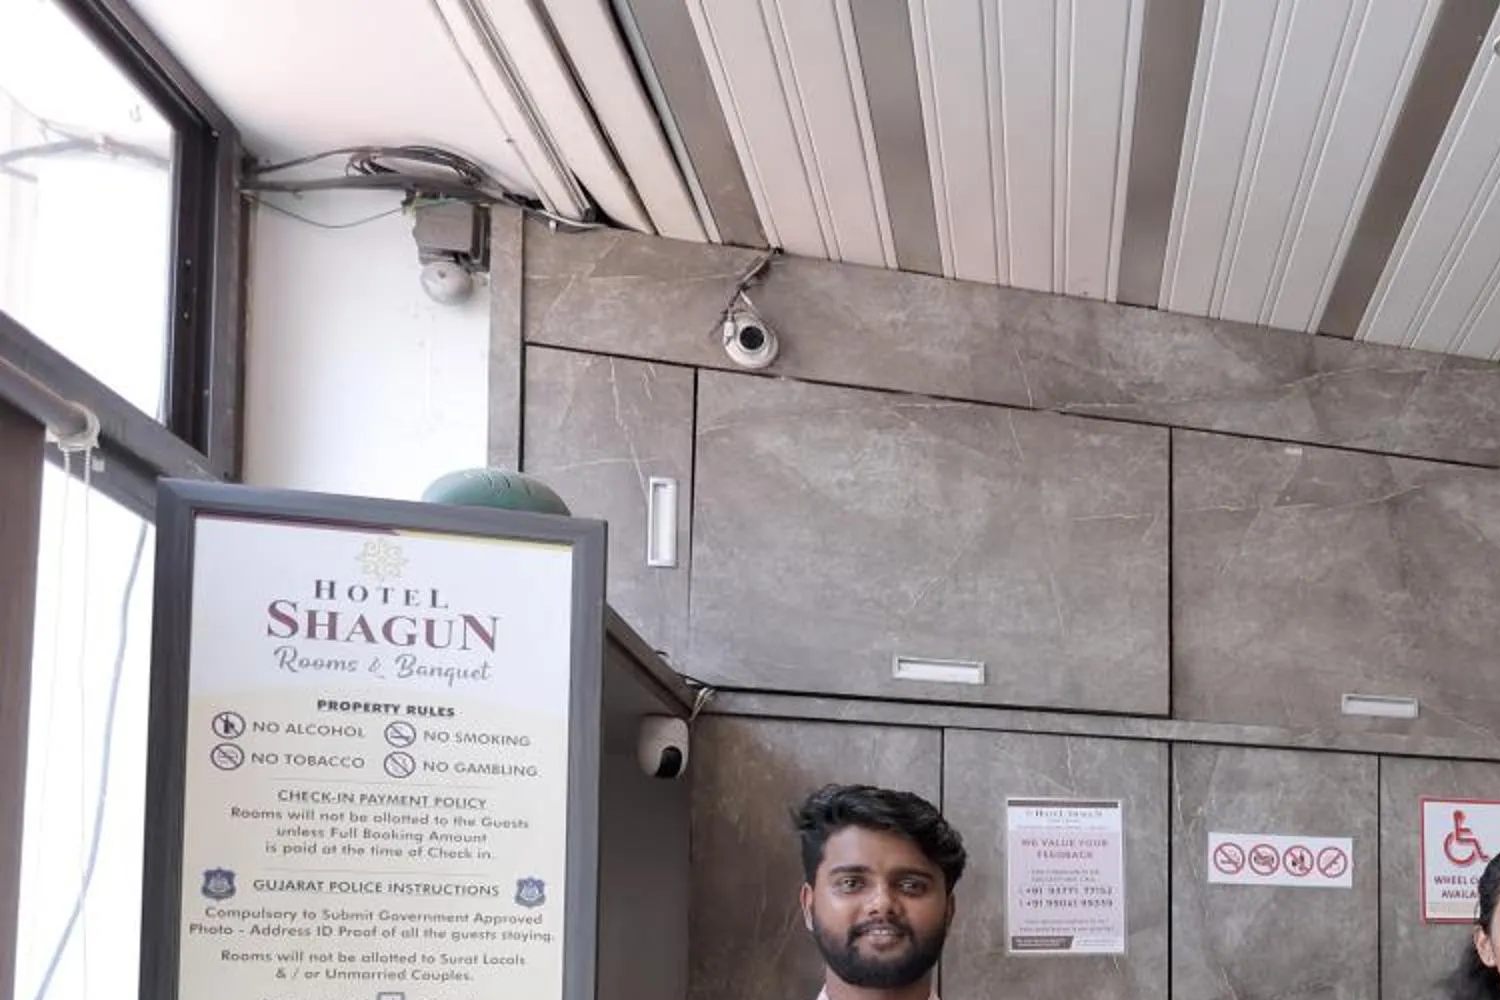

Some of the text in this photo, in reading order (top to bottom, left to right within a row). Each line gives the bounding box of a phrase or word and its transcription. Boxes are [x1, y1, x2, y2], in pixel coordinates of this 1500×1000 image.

[315, 579, 449, 609] HOTEL
[267, 599, 504, 653] SHAGUN
[273, 645, 491, 687] Rooms & Banquet
[317, 699, 455, 717] PROPERTY RULES
[252, 721, 365, 737] NO ALCOHOL
[423, 730, 531, 747] NO SMOKING
[251, 752, 365, 768] NO TOBACCO
[423, 760, 538, 777] NO GAMBLING
[277, 789, 487, 809] CHECK-IN PAYMENT POLICY
[231, 806, 529, 829] Rooms will not be allotted to the Guests
[276, 826, 487, 843] unless Full Booking Amount
[265, 841, 277, 853] is
[283, 842, 317, 858] paid
[322, 844, 337, 855] at
[342, 844, 365, 856] the
[370, 844, 403, 857] time
[408, 846, 424, 857] of
[428, 847, 472, 859] Check
[253, 879, 500, 896] GUJARAT POLICE INSTRUCTIONS
[1434, 875, 1468, 885] WHEEL
[205, 906, 543, 926] Compulsory to Submit Government Approved
[189, 923, 233, 936] Photo
[250, 925, 311, 937] Address
[317, 926, 333, 937] ID
[338, 926, 377, 937] Proof
[381, 927, 397, 938] of
[401, 927, 419, 938] all
[423, 927, 447, 938] the
[451, 930, 497, 942] guests
[221, 950, 525, 965] Rooms will not be allotted to Surat Locals
[275, 968, 286, 979] &
[304, 971, 321, 979] or
[326, 969, 407, 981] Unmarried
